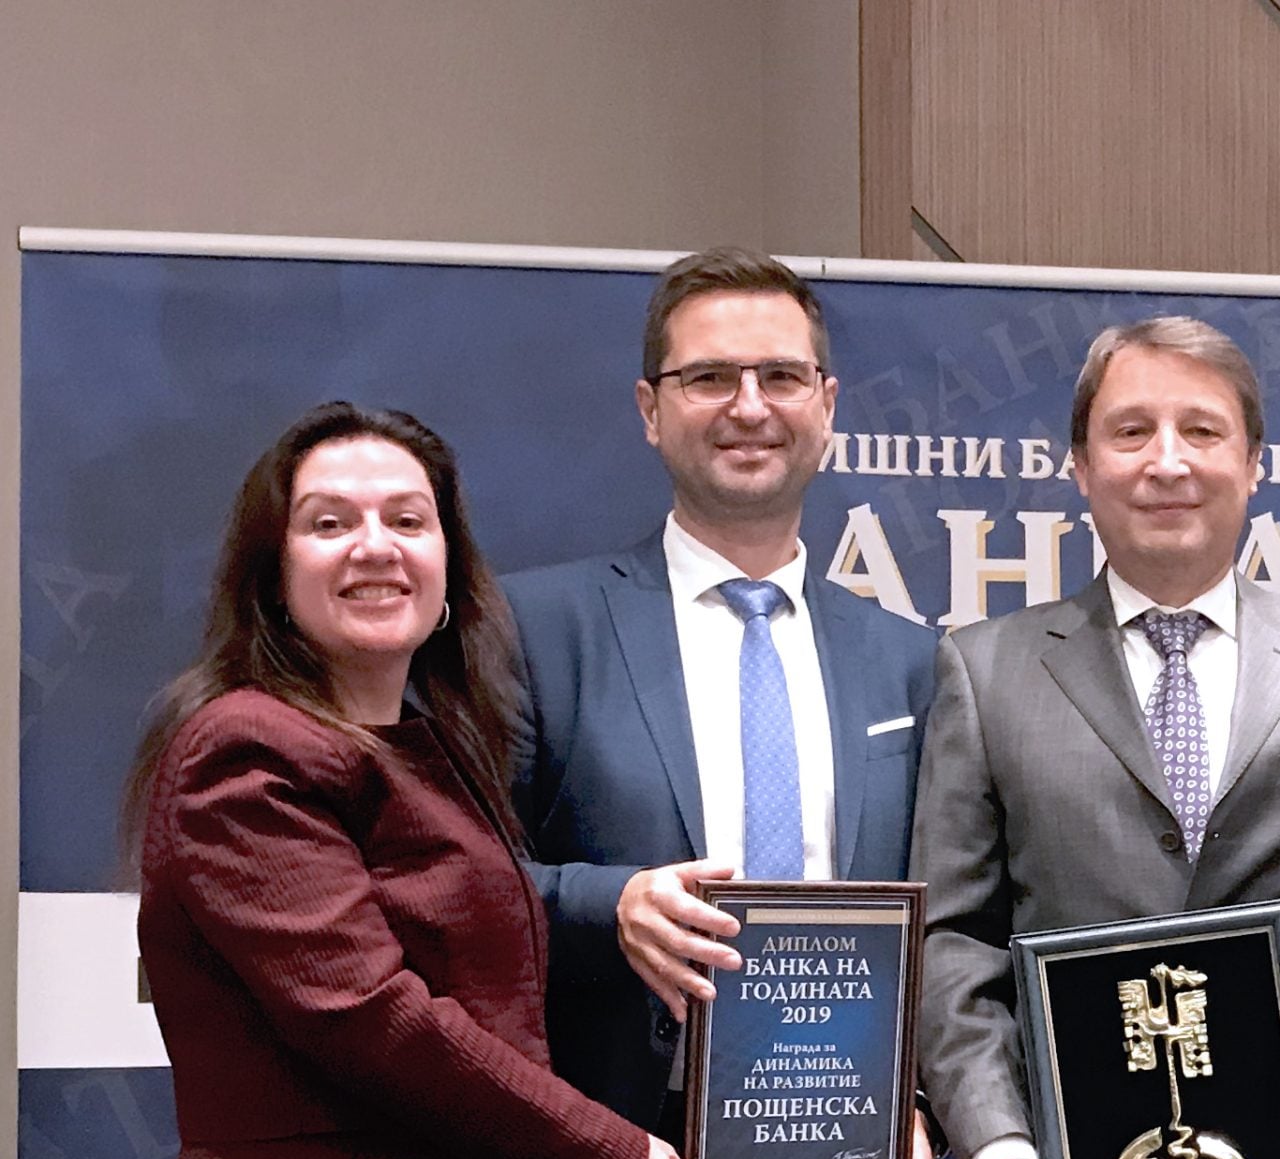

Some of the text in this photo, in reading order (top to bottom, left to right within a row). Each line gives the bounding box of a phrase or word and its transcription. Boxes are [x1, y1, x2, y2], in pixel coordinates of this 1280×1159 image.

[761, 935, 856, 955] ДИПЛОМ
[745, 957, 871, 976] БАНКА НА
[740, 981, 873, 1004] ГОДИНАТА
[781, 1006, 832, 1024] 2019
[773, 1042, 837, 1055] Награда за
[751, 1056, 854, 1074] ДИНАМИКА
[743, 1074, 861, 1090] НА РАЗВИТИЕ
[723, 1095, 878, 1121] ПОЩЕНСКА
[754, 1121, 844, 1144] БАНКА
